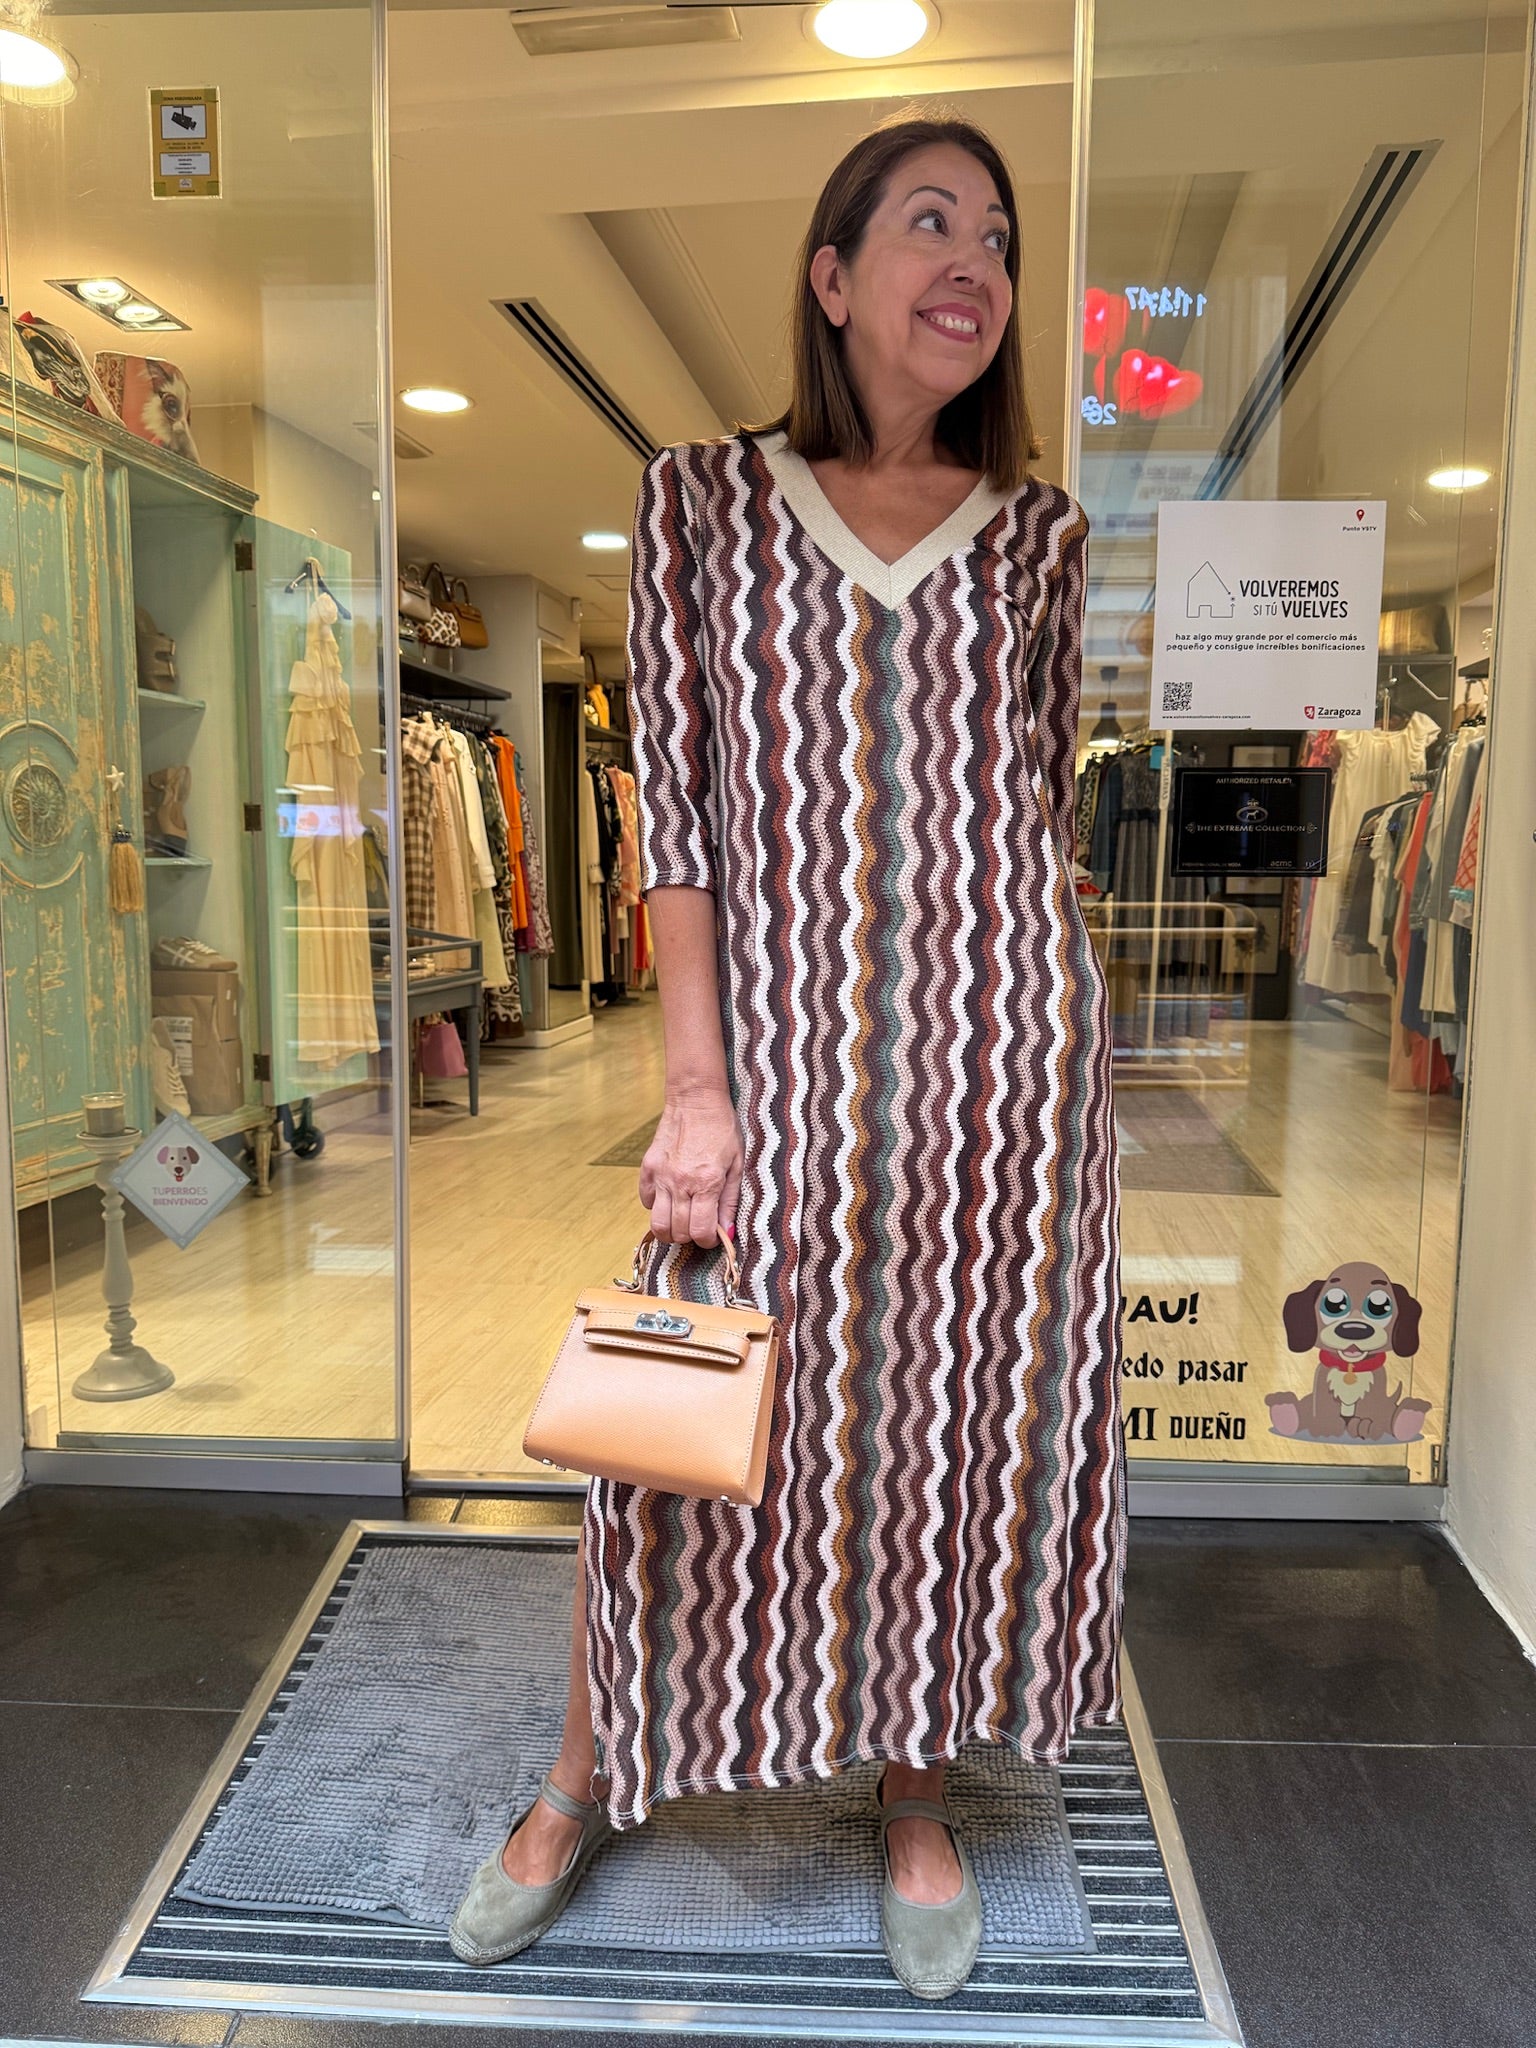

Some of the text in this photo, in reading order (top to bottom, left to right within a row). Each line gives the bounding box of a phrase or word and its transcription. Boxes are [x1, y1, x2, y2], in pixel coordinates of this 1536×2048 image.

[1239, 580, 1339, 598] VOLVEREMOS
[1253, 600, 1349, 618] SI TÚ VUELVES
[1175, 633, 1191, 641] haz
[1193, 633, 1212, 642] algo
[1214, 634, 1234, 642] muy
[1235, 633, 1266, 642] grande
[1269, 633, 1284, 642] por
[1296, 633, 1337, 641] comercio
[1339, 633, 1358, 641] más
[1166, 642, 1366, 652] pequeño y consigue increíbles bonificaciones
[1317, 707, 1361, 718] Zaragoza
[152, 1198, 209, 1206] BIENVENIDO
[1121, 1292, 1199, 1324] AU!
[1178, 1360, 1248, 1385] pasar
[1169, 1412, 1246, 1440] DUEÑO
